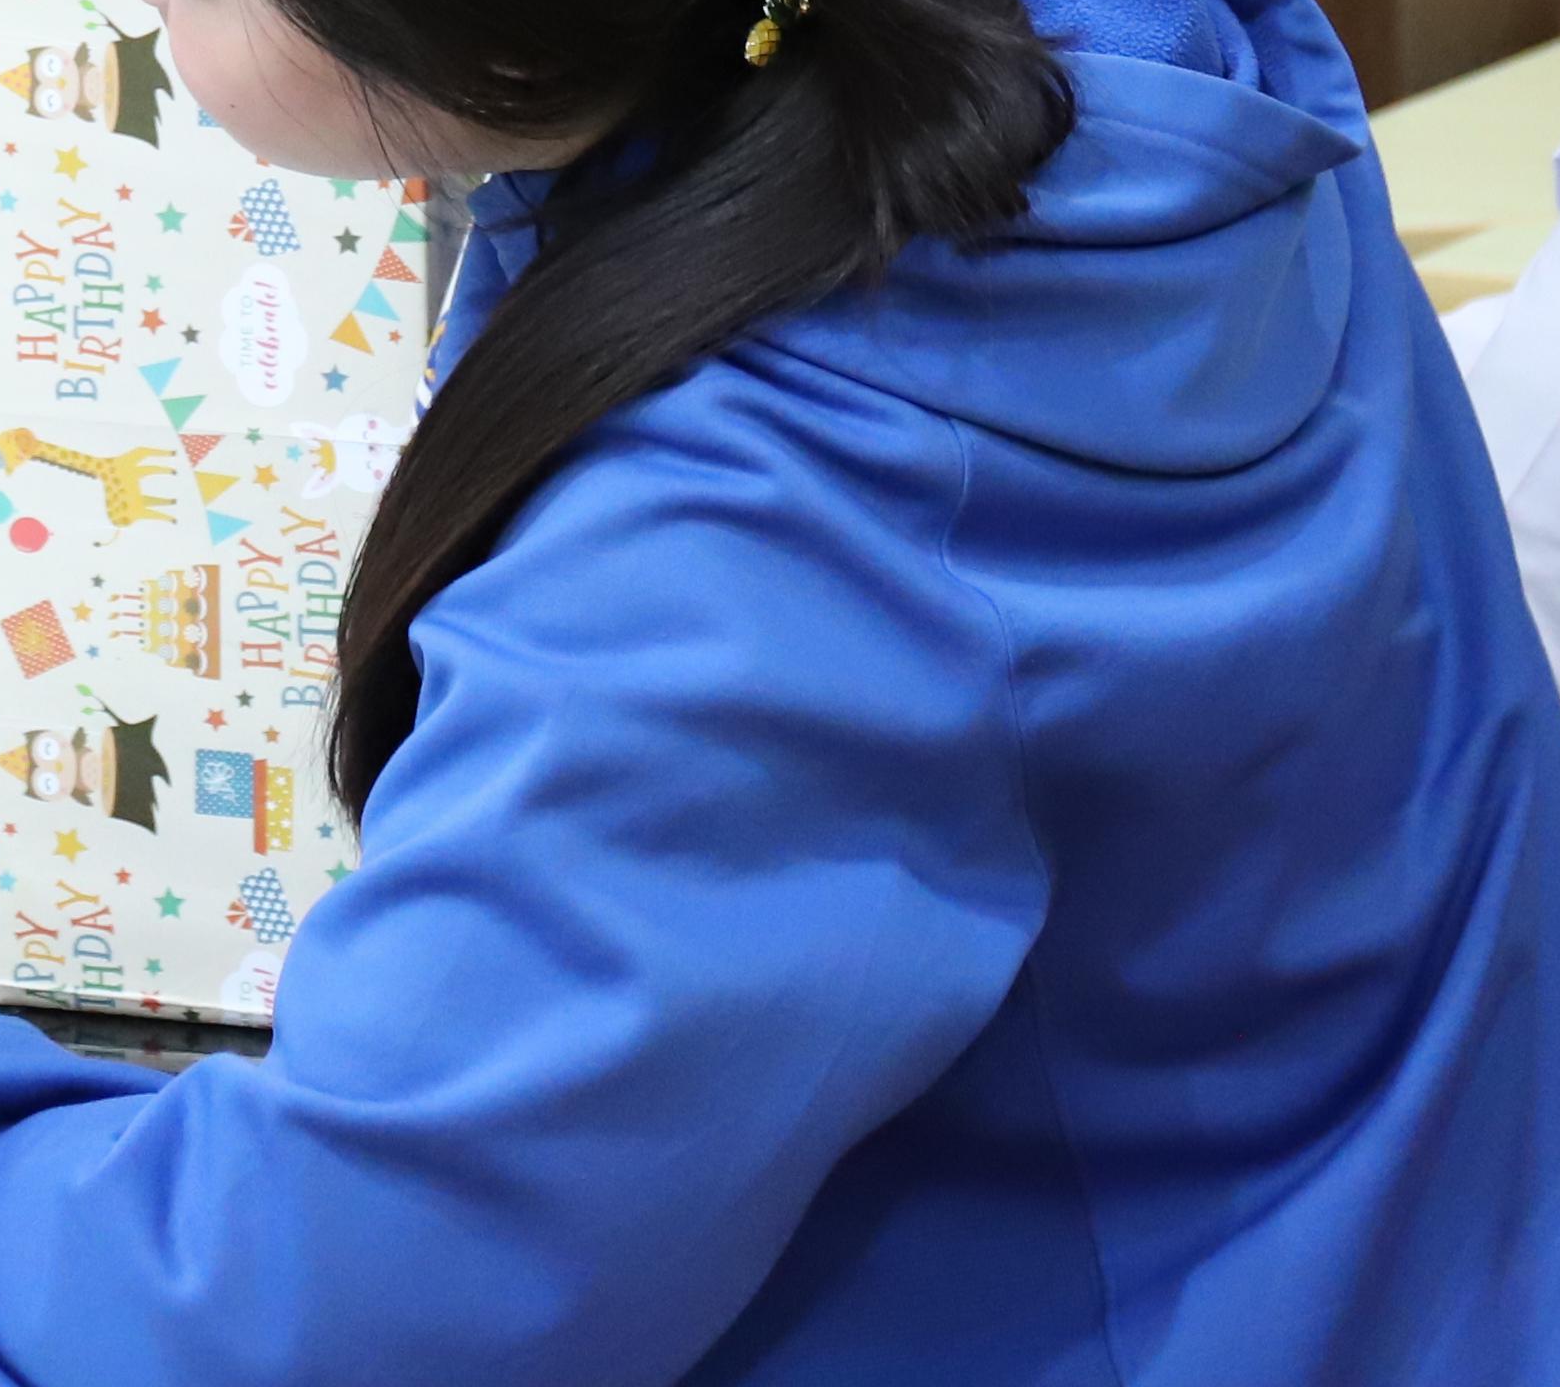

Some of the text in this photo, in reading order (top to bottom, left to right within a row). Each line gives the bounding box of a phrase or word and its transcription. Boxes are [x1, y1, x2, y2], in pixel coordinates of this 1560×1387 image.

[13, 229, 67, 363] HAPPY
[55, 197, 125, 401] BIRTHDAY
[235, 538, 291, 670] HAPPY
[281, 506, 346, 709] BIRTHDAY
[13, 910, 71, 1009] APPY
